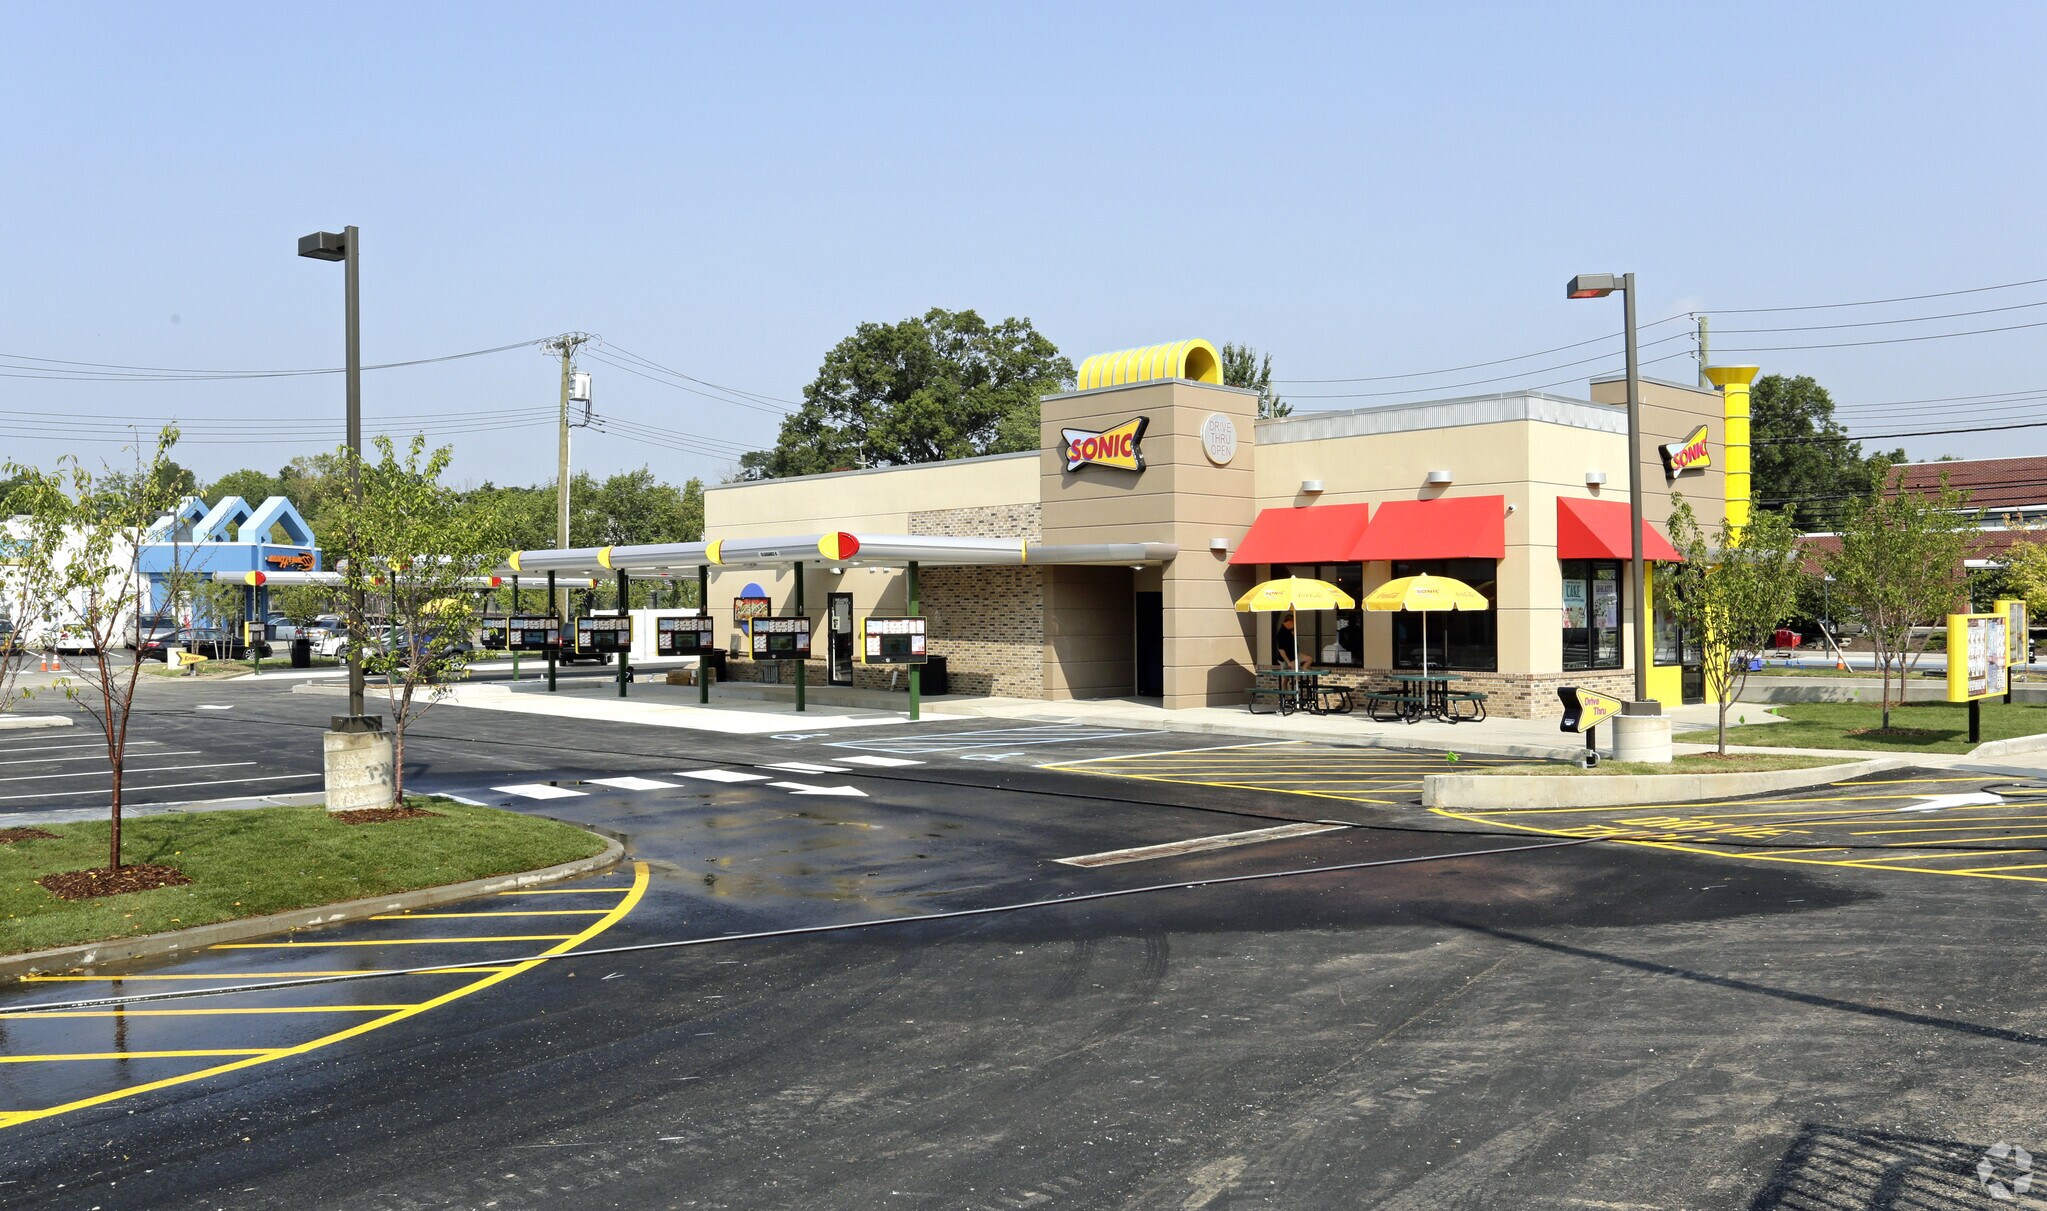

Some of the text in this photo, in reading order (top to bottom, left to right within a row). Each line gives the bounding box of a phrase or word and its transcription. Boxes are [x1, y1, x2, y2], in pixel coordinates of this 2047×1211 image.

[1209, 420, 1232, 433] DRIVE
[1210, 432, 1232, 445] THRU
[1069, 433, 1133, 463] SONIC
[1210, 444, 1232, 456] OPEN
[1673, 438, 1708, 470] SONIC
[1584, 696, 1600, 706] Drive
[1593, 706, 1607, 716] Thru
